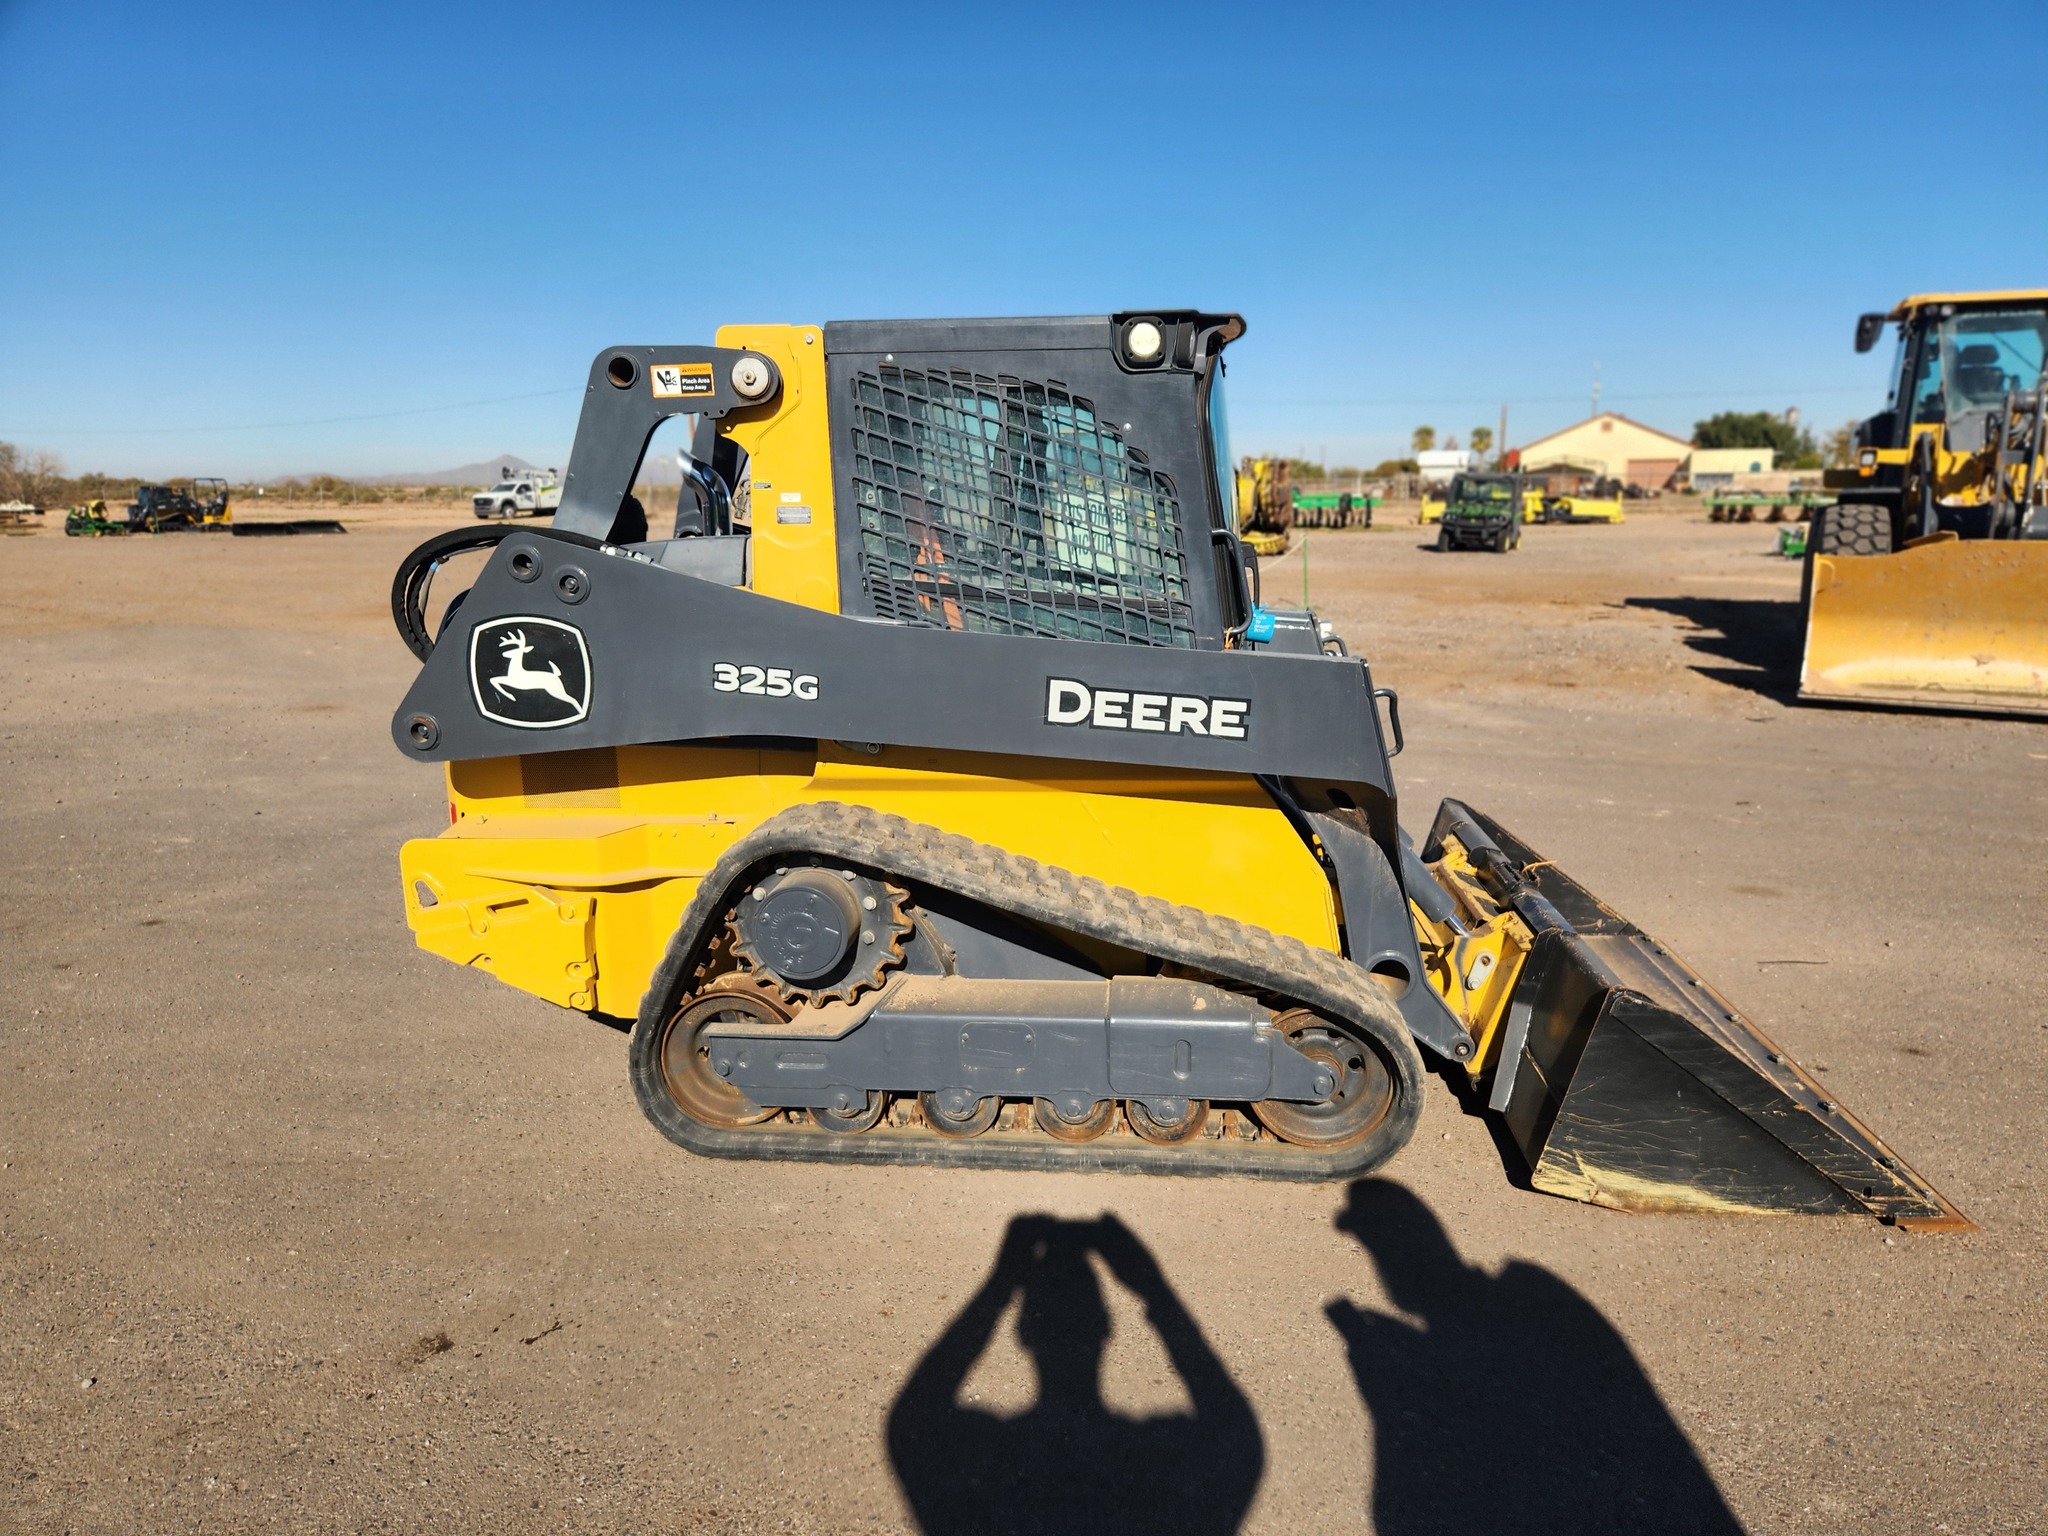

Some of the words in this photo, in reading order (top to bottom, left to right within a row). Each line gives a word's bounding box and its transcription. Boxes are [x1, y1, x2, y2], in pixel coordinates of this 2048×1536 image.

[1064, 503, 1123, 526] USOMR
[713, 662, 819, 701] 325G
[1047, 679, 1248, 738] DEERE
